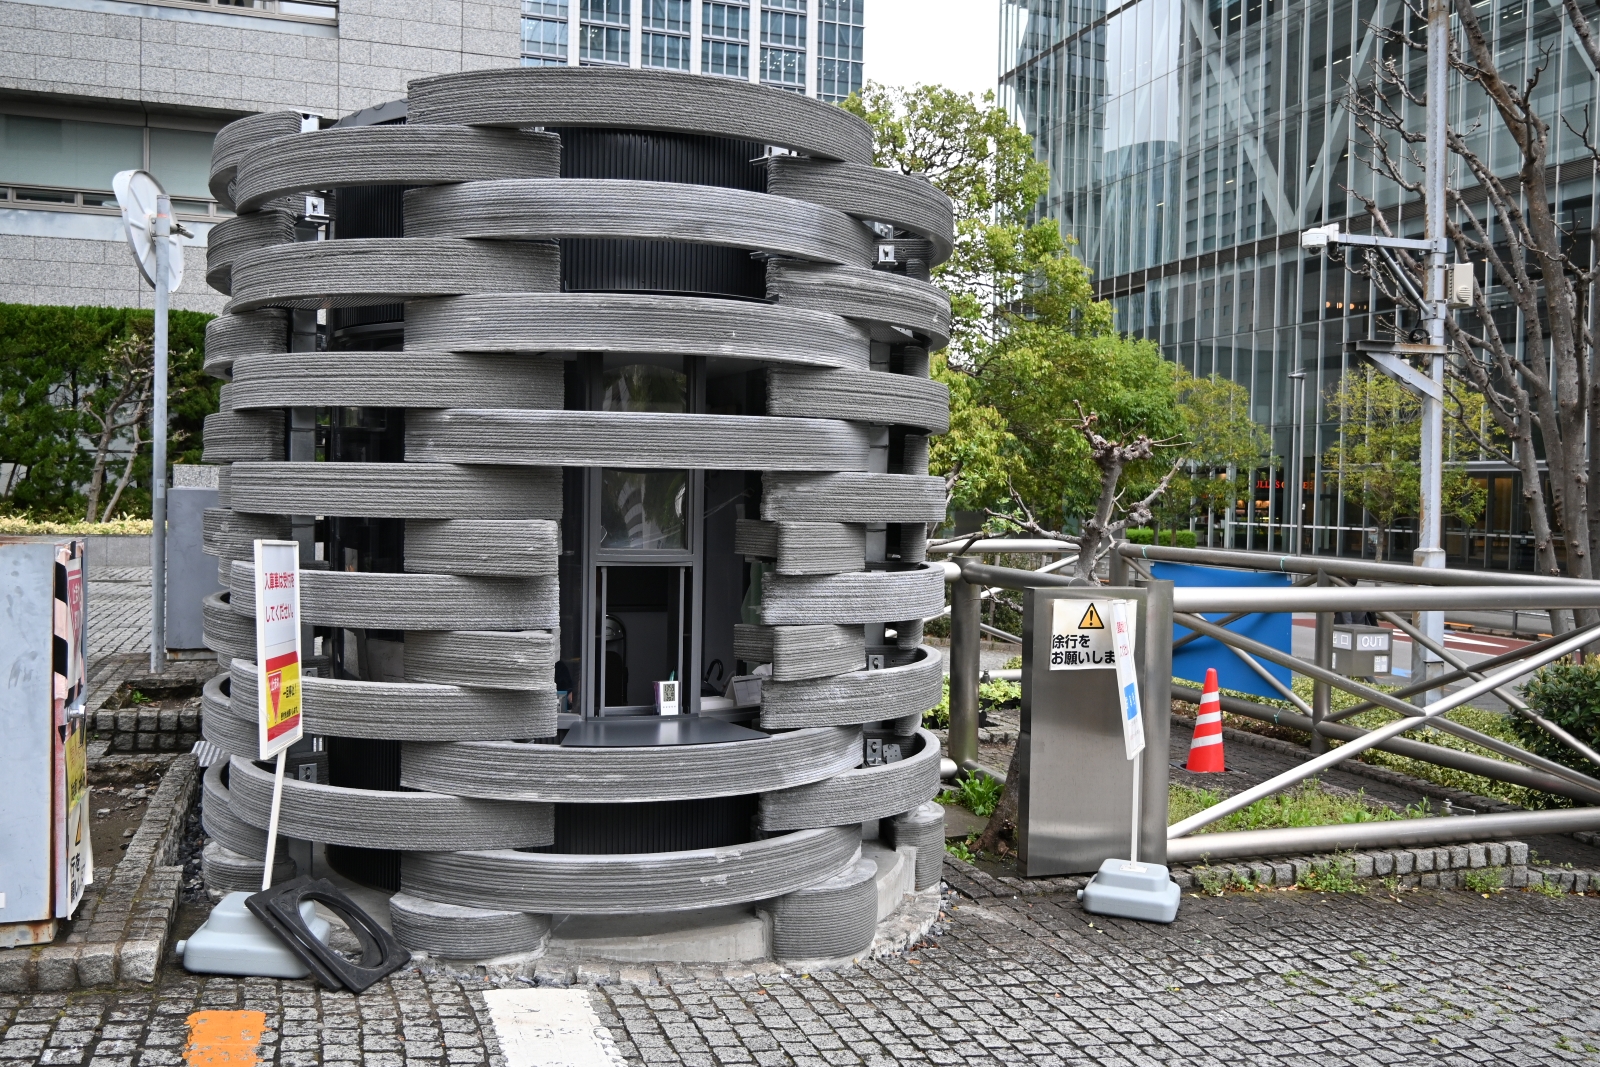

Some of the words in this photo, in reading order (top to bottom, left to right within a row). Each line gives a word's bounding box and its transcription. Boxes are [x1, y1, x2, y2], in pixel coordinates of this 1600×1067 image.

[1362, 636, 1384, 647] OUT
[1051, 651, 1115, 665] お願いしま
